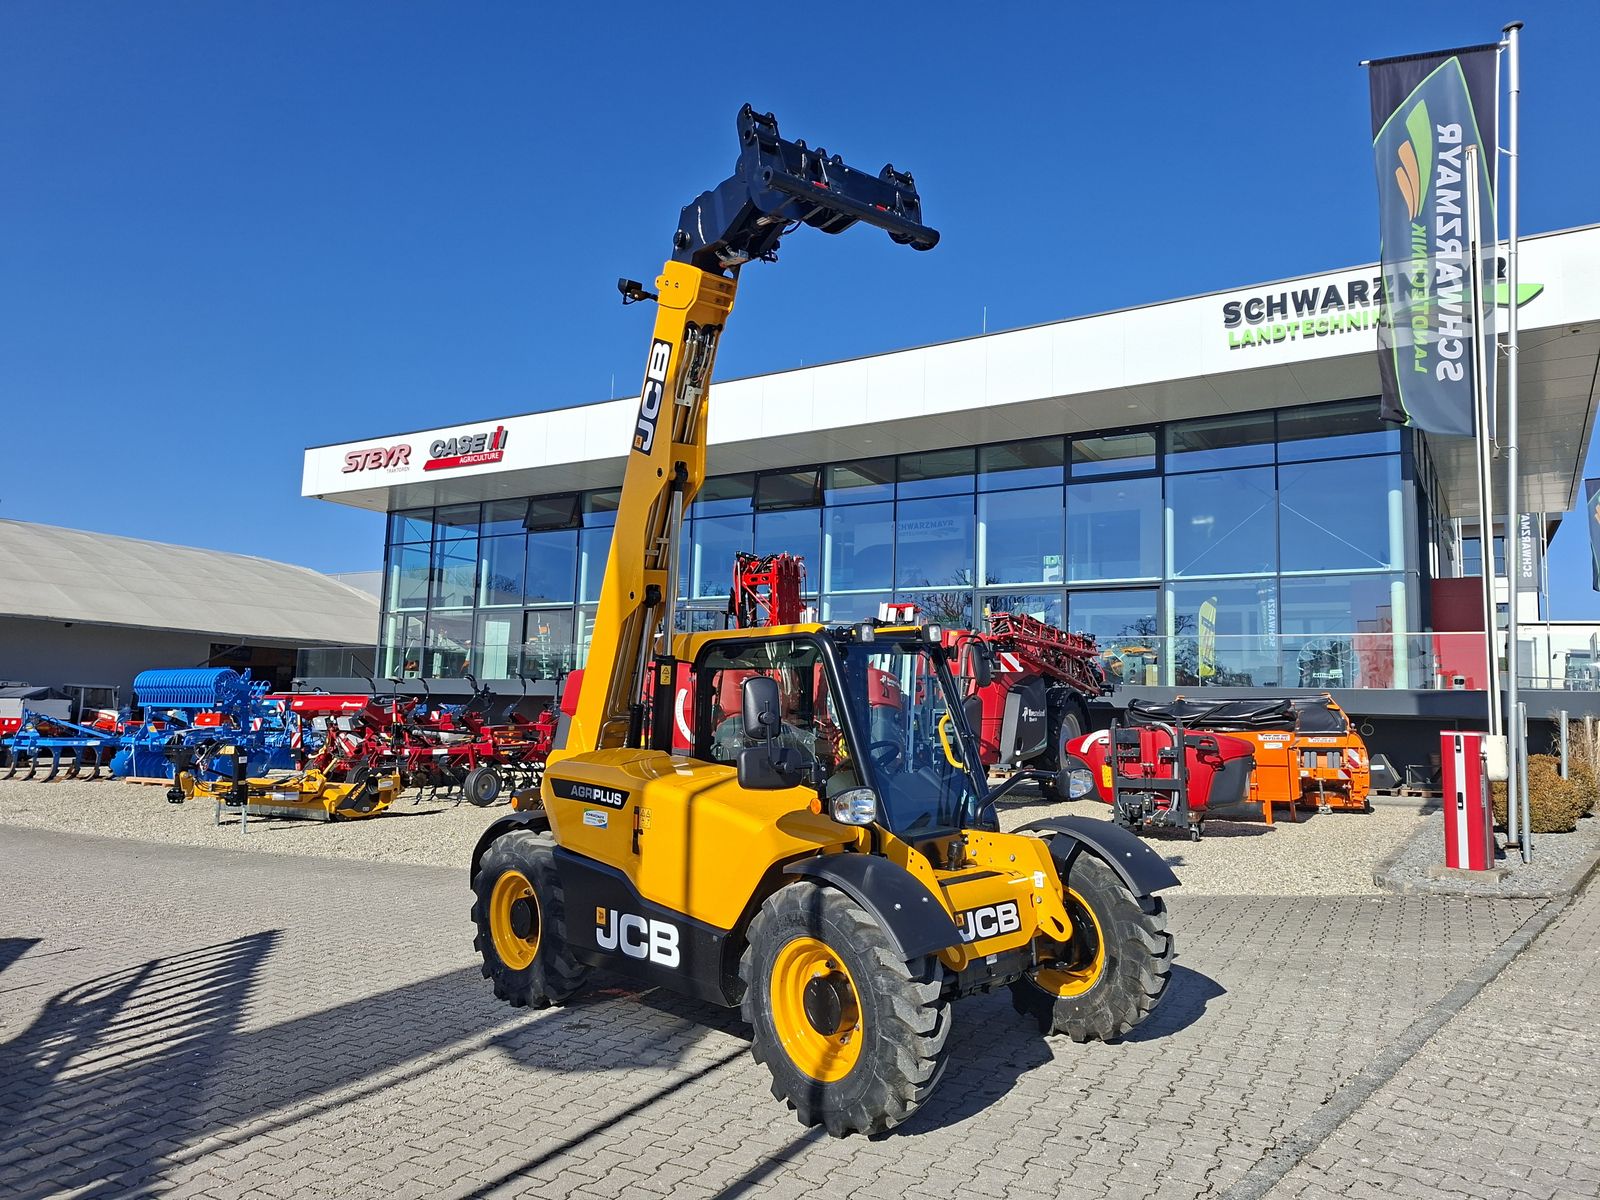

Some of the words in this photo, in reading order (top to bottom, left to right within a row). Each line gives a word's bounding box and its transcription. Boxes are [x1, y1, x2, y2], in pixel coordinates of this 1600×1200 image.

[638, 342, 671, 452] JCB
[341, 444, 411, 473] STEYR
[429, 433, 487, 459] CASE
[459, 452, 500, 464] AGRICULTURE
[596, 909, 680, 968] JCB
[958, 902, 1020, 942] JCB
